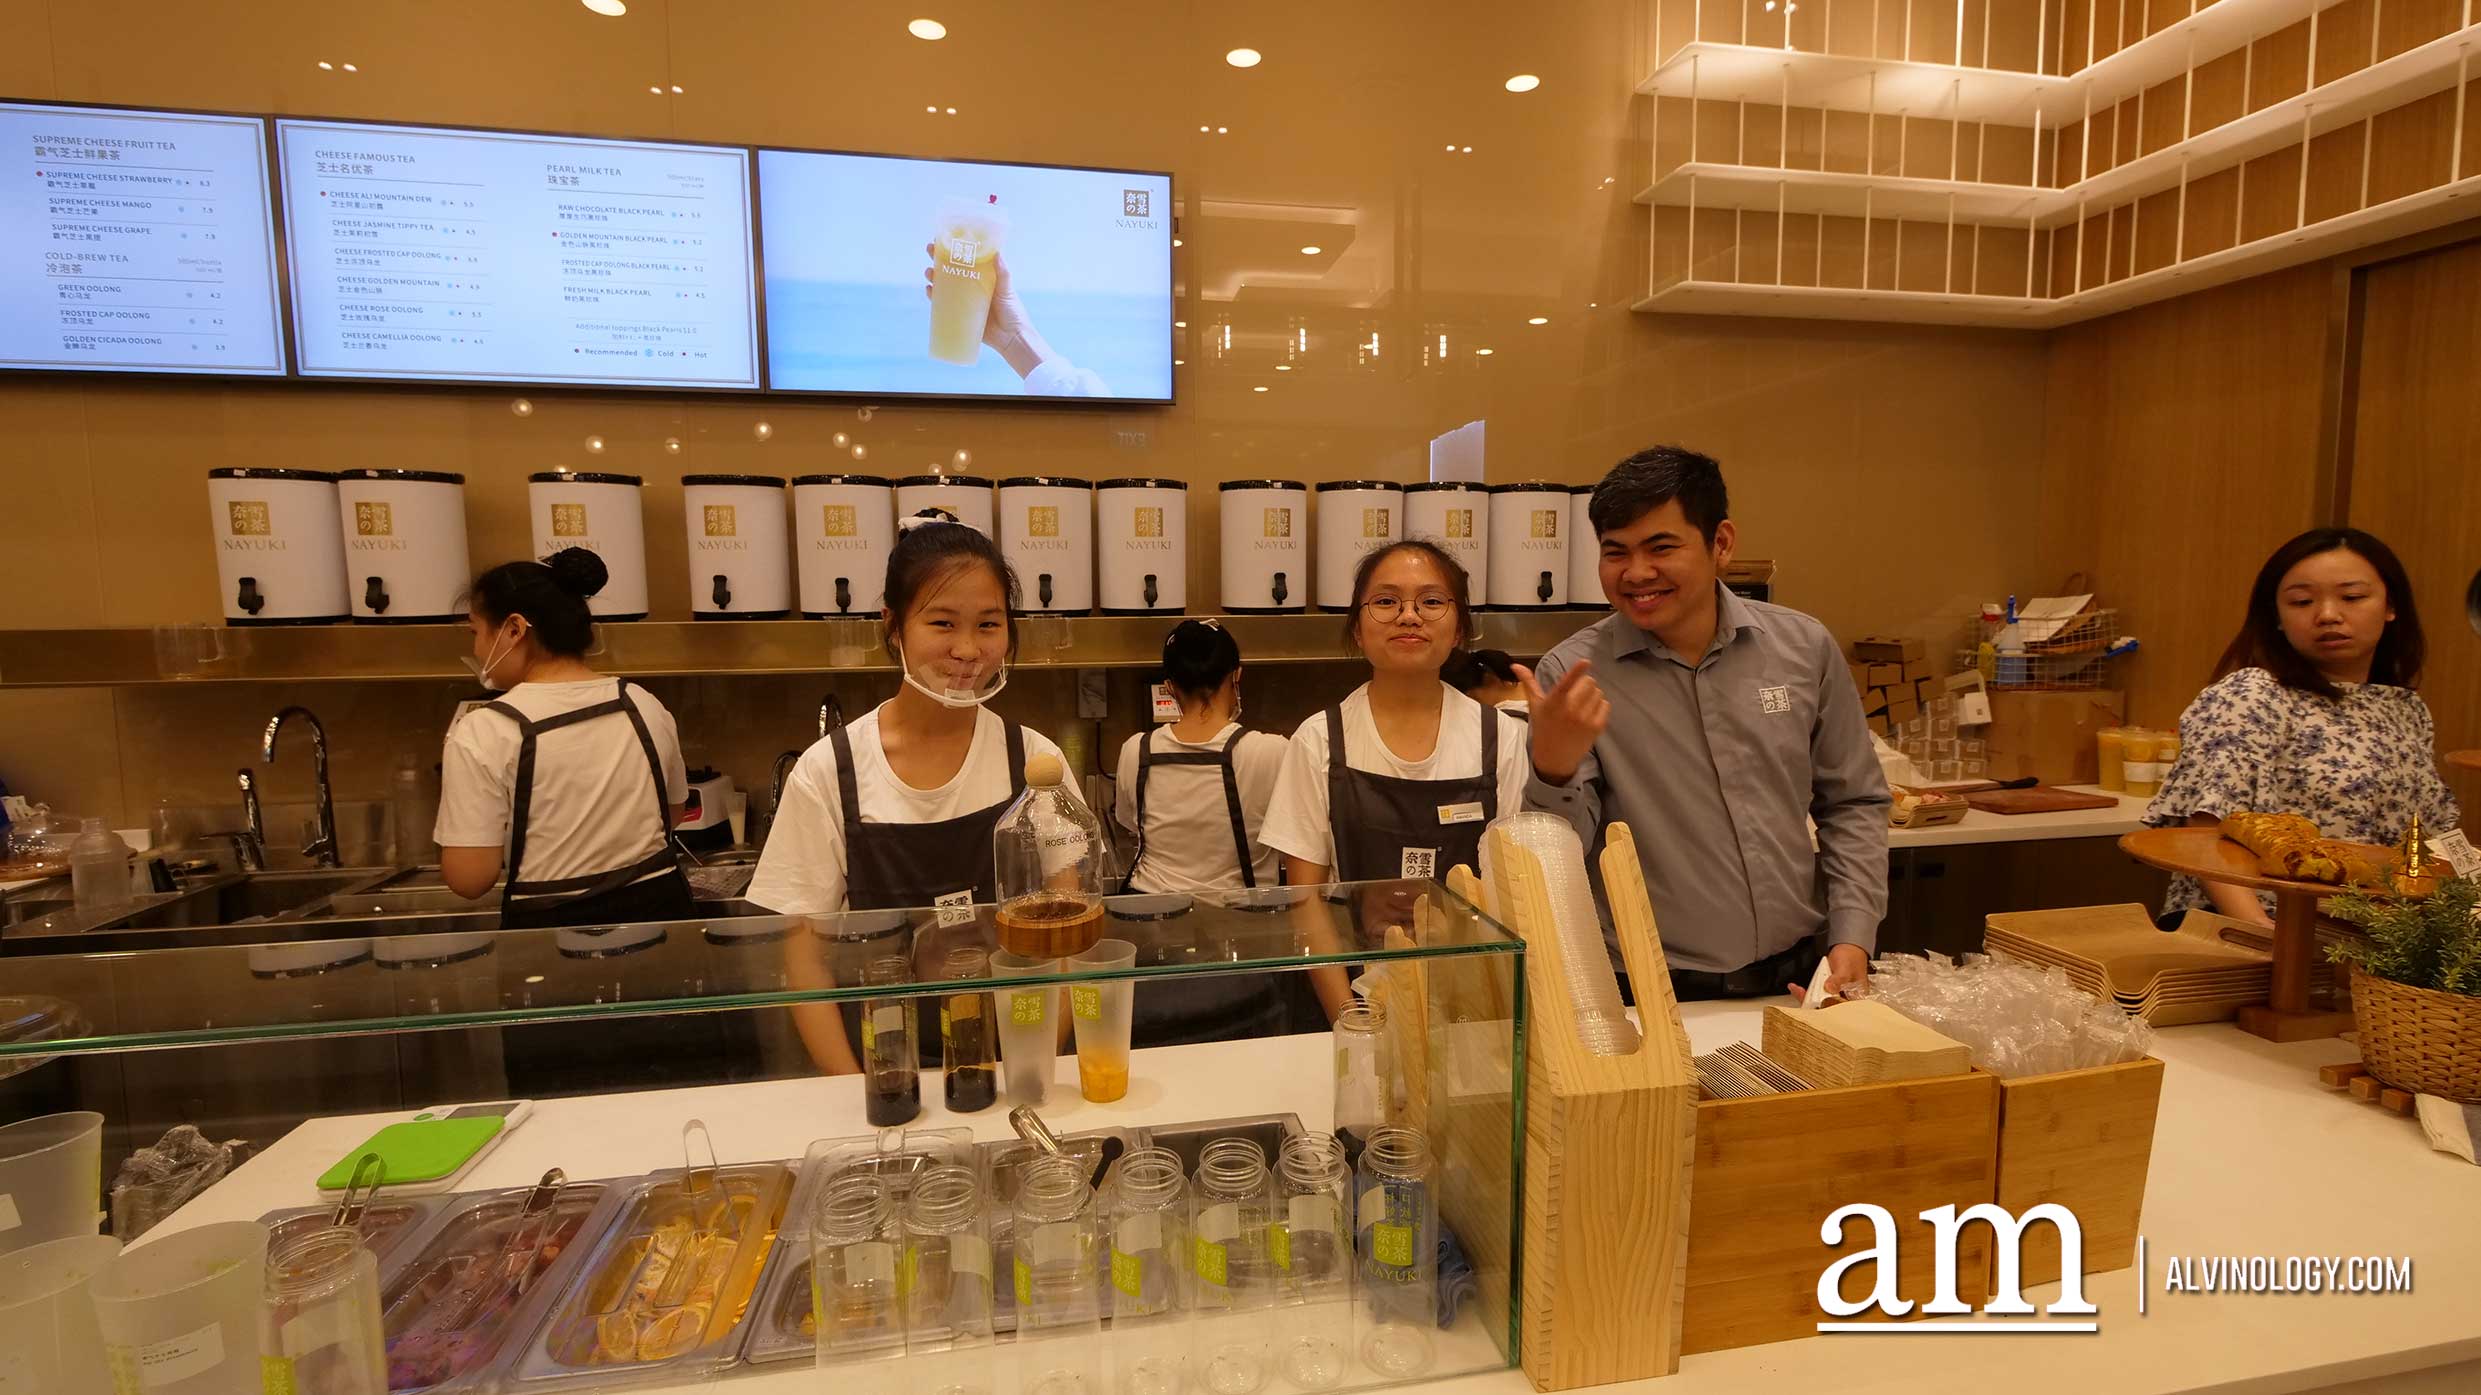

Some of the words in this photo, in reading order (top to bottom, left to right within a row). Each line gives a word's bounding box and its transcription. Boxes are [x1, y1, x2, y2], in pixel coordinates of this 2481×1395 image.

[33, 135, 82, 146] SUPREME
[84, 138, 122, 147] CHEESE
[125, 140, 154, 149] FRUIT
[156, 141, 176, 150] TEA
[315, 151, 352, 160] CHEESE
[354, 153, 395, 162] FAMOUS
[399, 155, 416, 163] TEA
[547, 165, 576, 174] PEARL
[579, 166, 602, 175] MILK
[604, 168, 622, 176] TEA
[46, 171, 84, 180] SUPREME
[87, 174, 117, 182] CHEESE
[119, 175, 173, 185] STRAWBERRY
[49, 198, 87, 206] SUPREME
[88, 199, 120, 207] CHEESE
[122, 200, 151, 208] MANGO
[374, 194, 414, 202] MOUNTAIN
[575, 205, 616, 213] CHOCOLATE
[618, 207, 641, 215] BLACK
[1126, 204, 1148, 214] の茶
[52, 224, 90, 232] SUPREME
[363, 221, 395, 229] JASMINE
[1115, 219, 1158, 230] NAYUKI
[589, 233, 623, 241] MOUNTAIN
[45, 252, 106, 262] COLD-BREW
[109, 254, 128, 262] TEA
[942, 265, 981, 280] NAYUKI
[368, 277, 399, 285] GOLDEN
[58, 284, 85, 292] GREEN
[87, 285, 121, 293] OOLONG
[61, 310, 97, 318] FROSTED
[584, 348, 638, 356] Recommended
[224, 539, 288, 550] NAYUKI
[351, 540, 407, 550] NAYUKI
[698, 540, 748, 550] NAYUKI
[816, 540, 868, 550] NAYUKI
[1020, 540, 1069, 550] NAYUKI
[1254, 541, 1296, 550] NAYUKI
[1521, 541, 1562, 550] NAYUKI
[1766, 700, 1787, 710] の茶
[1046, 838, 1066, 848] ROSE
[1406, 852, 1432, 865] 奈雪
[1406, 865, 1431, 877] の茶
[1014, 997, 1041, 1010] 奈雪
[1074, 1002, 1098, 1016] の茶
[1014, 1010, 1042, 1022] の茶
[1377, 1246, 1408, 1262] の茶
[1366, 1259, 1422, 1282] NAYUKI
